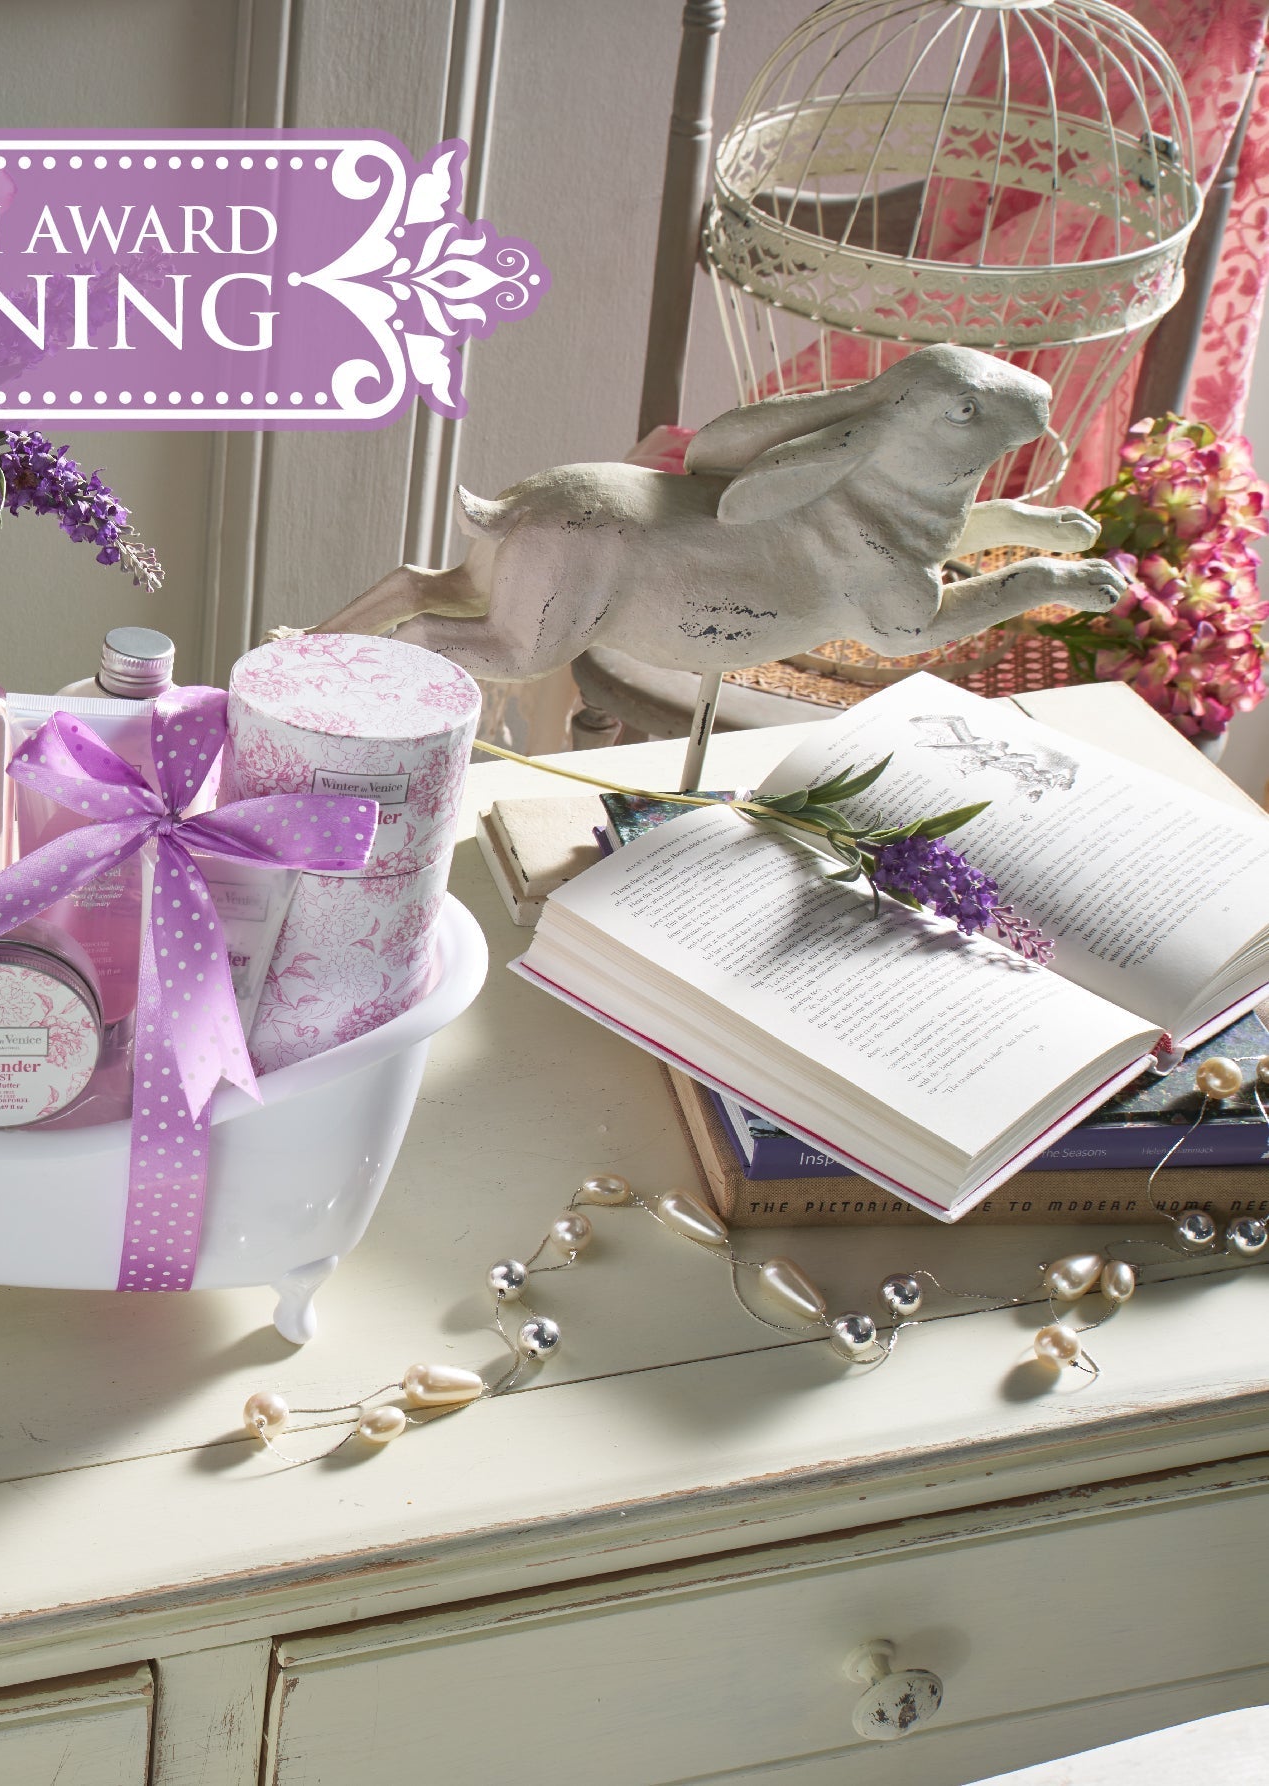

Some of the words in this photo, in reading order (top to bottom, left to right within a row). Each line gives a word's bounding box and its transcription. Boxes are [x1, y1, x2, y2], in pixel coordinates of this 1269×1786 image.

[321, 777, 360, 792] Winter
[370, 782, 403, 793] Venice
[5, 1034, 42, 1045] Venice
[799, 1152, 836, 1167] Insp
[1061, 1148, 1107, 1159] Seasons
[750, 1202, 789, 1213] THE
[805, 1201, 914, 1213] PICTORIAL
[1009, 1201, 1032, 1212] TO
[1048, 1201, 1138, 1212] MODERN
[1155, 1200, 1213, 1211] HOME
